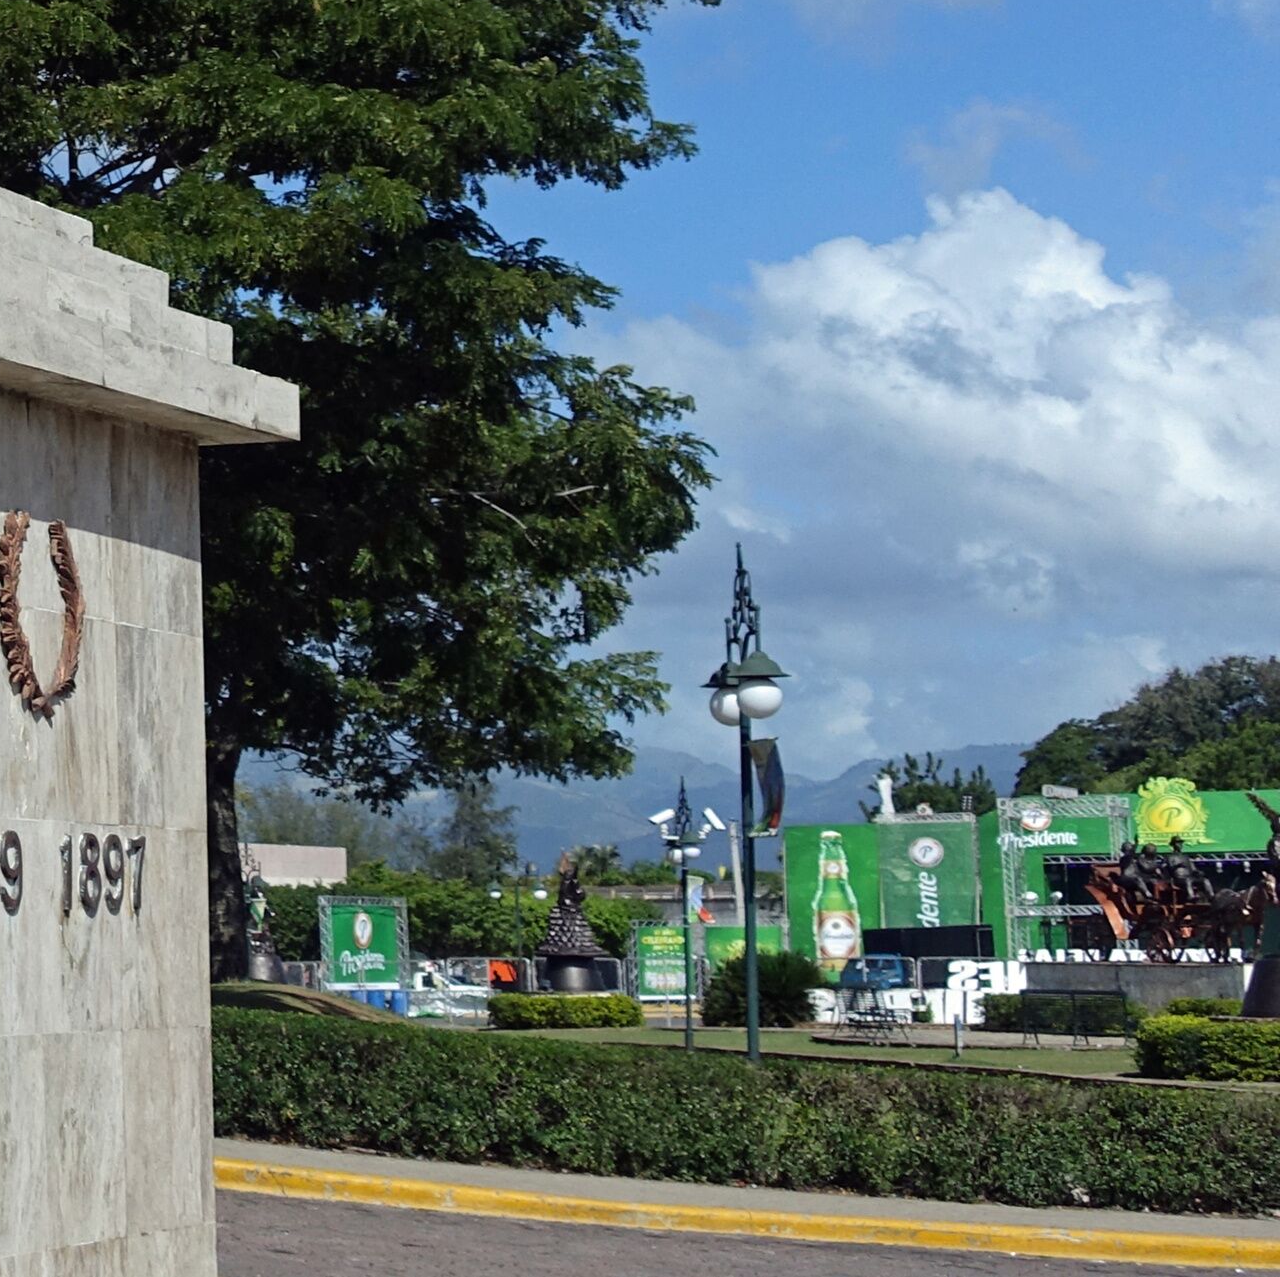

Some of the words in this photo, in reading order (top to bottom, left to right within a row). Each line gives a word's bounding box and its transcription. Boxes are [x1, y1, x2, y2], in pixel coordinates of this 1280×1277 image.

[997, 830, 1078, 850] Presidente
[60, 832, 146, 918] 1897
[917, 872, 940, 928] dente
